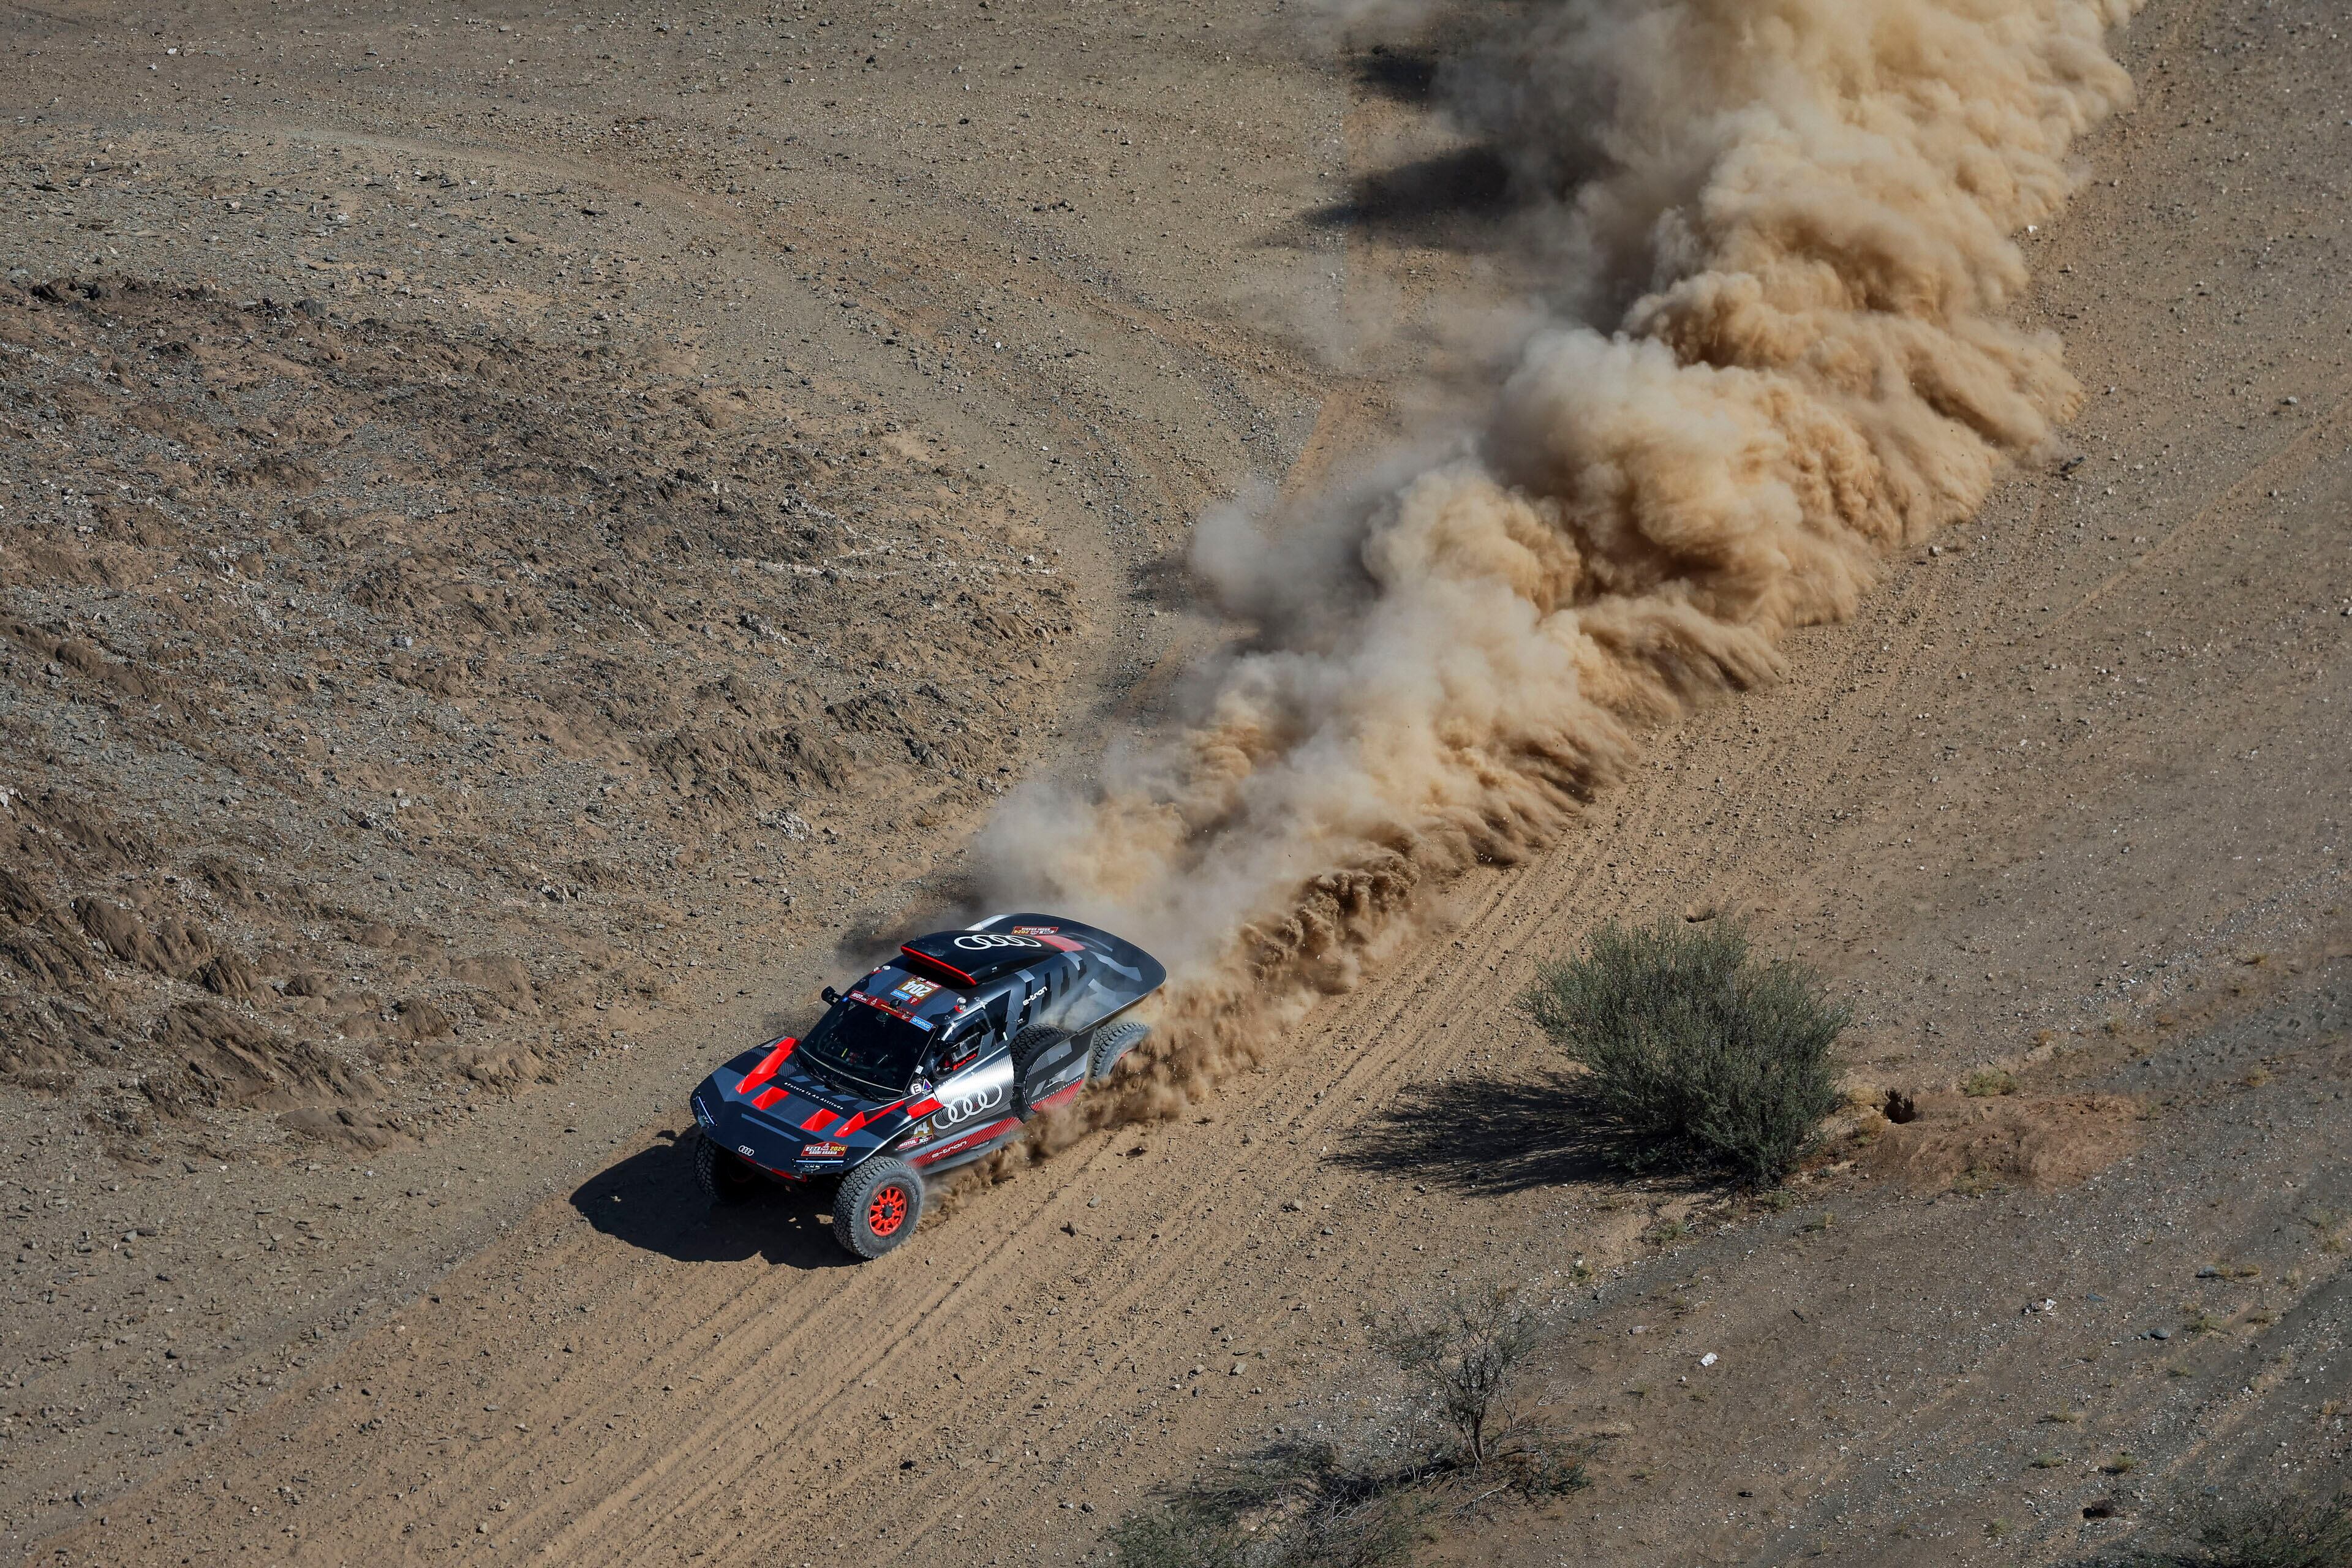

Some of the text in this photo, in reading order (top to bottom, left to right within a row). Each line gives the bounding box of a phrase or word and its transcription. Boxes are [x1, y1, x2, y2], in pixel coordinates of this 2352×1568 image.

[893, 990, 910, 999] aramco
[901, 980, 932, 997] 204
[1022, 986, 1047, 1006] e-tron
[912, 1017, 930, 1029] aramco
[913, 1084, 921, 1093] E
[1063, 1077, 1081, 1088] Attitude
[820, 1098, 843, 1110] Attitude
[932, 1140, 967, 1158] e-tron
